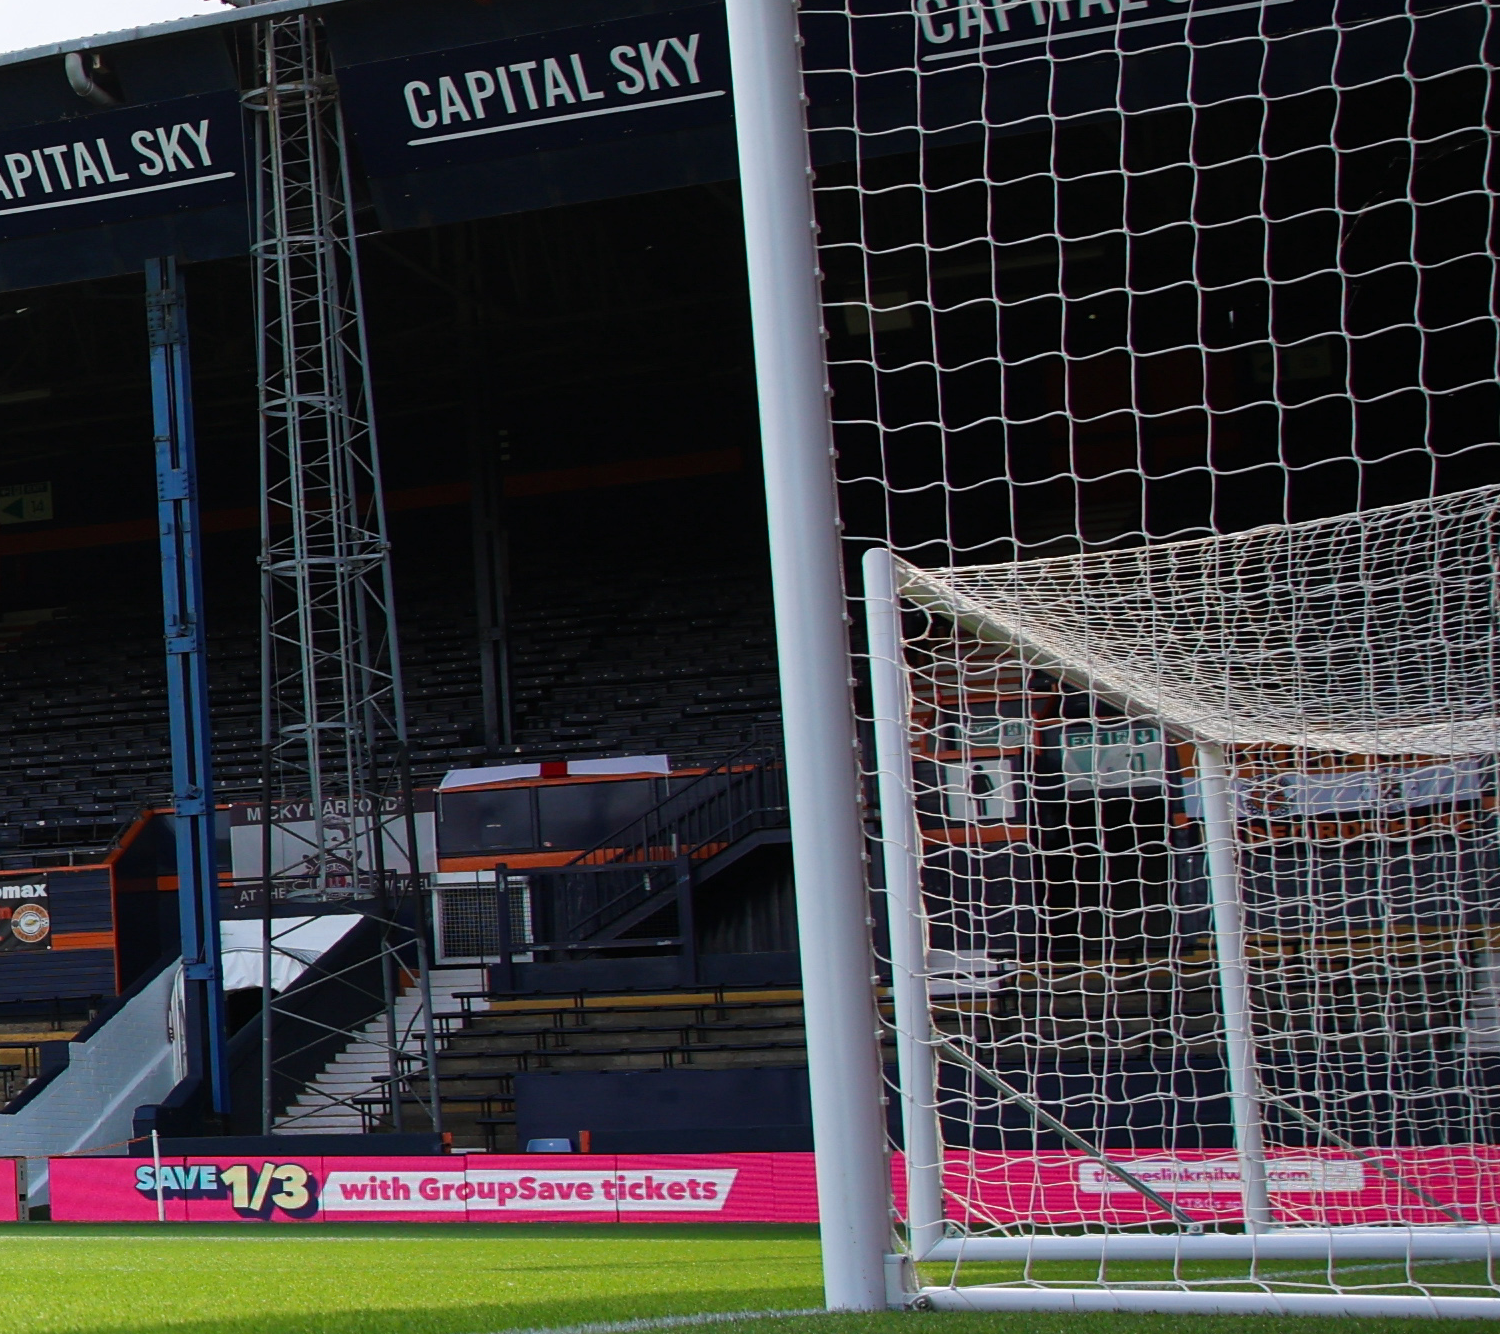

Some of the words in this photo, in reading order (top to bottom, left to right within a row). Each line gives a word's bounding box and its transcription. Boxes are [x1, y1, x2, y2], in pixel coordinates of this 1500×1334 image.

[403, 53, 605, 129] CAPITAL
[609, 33, 700, 95] SKY
[130, 119, 213, 176] SKY
[135, 1164, 217, 1192] SAVE
[221, 1163, 312, 1209] 1/3
[340, 1175, 410, 1202] with
[419, 1176, 594, 1207] GroupSave
[601, 1175, 718, 1201] tickets
